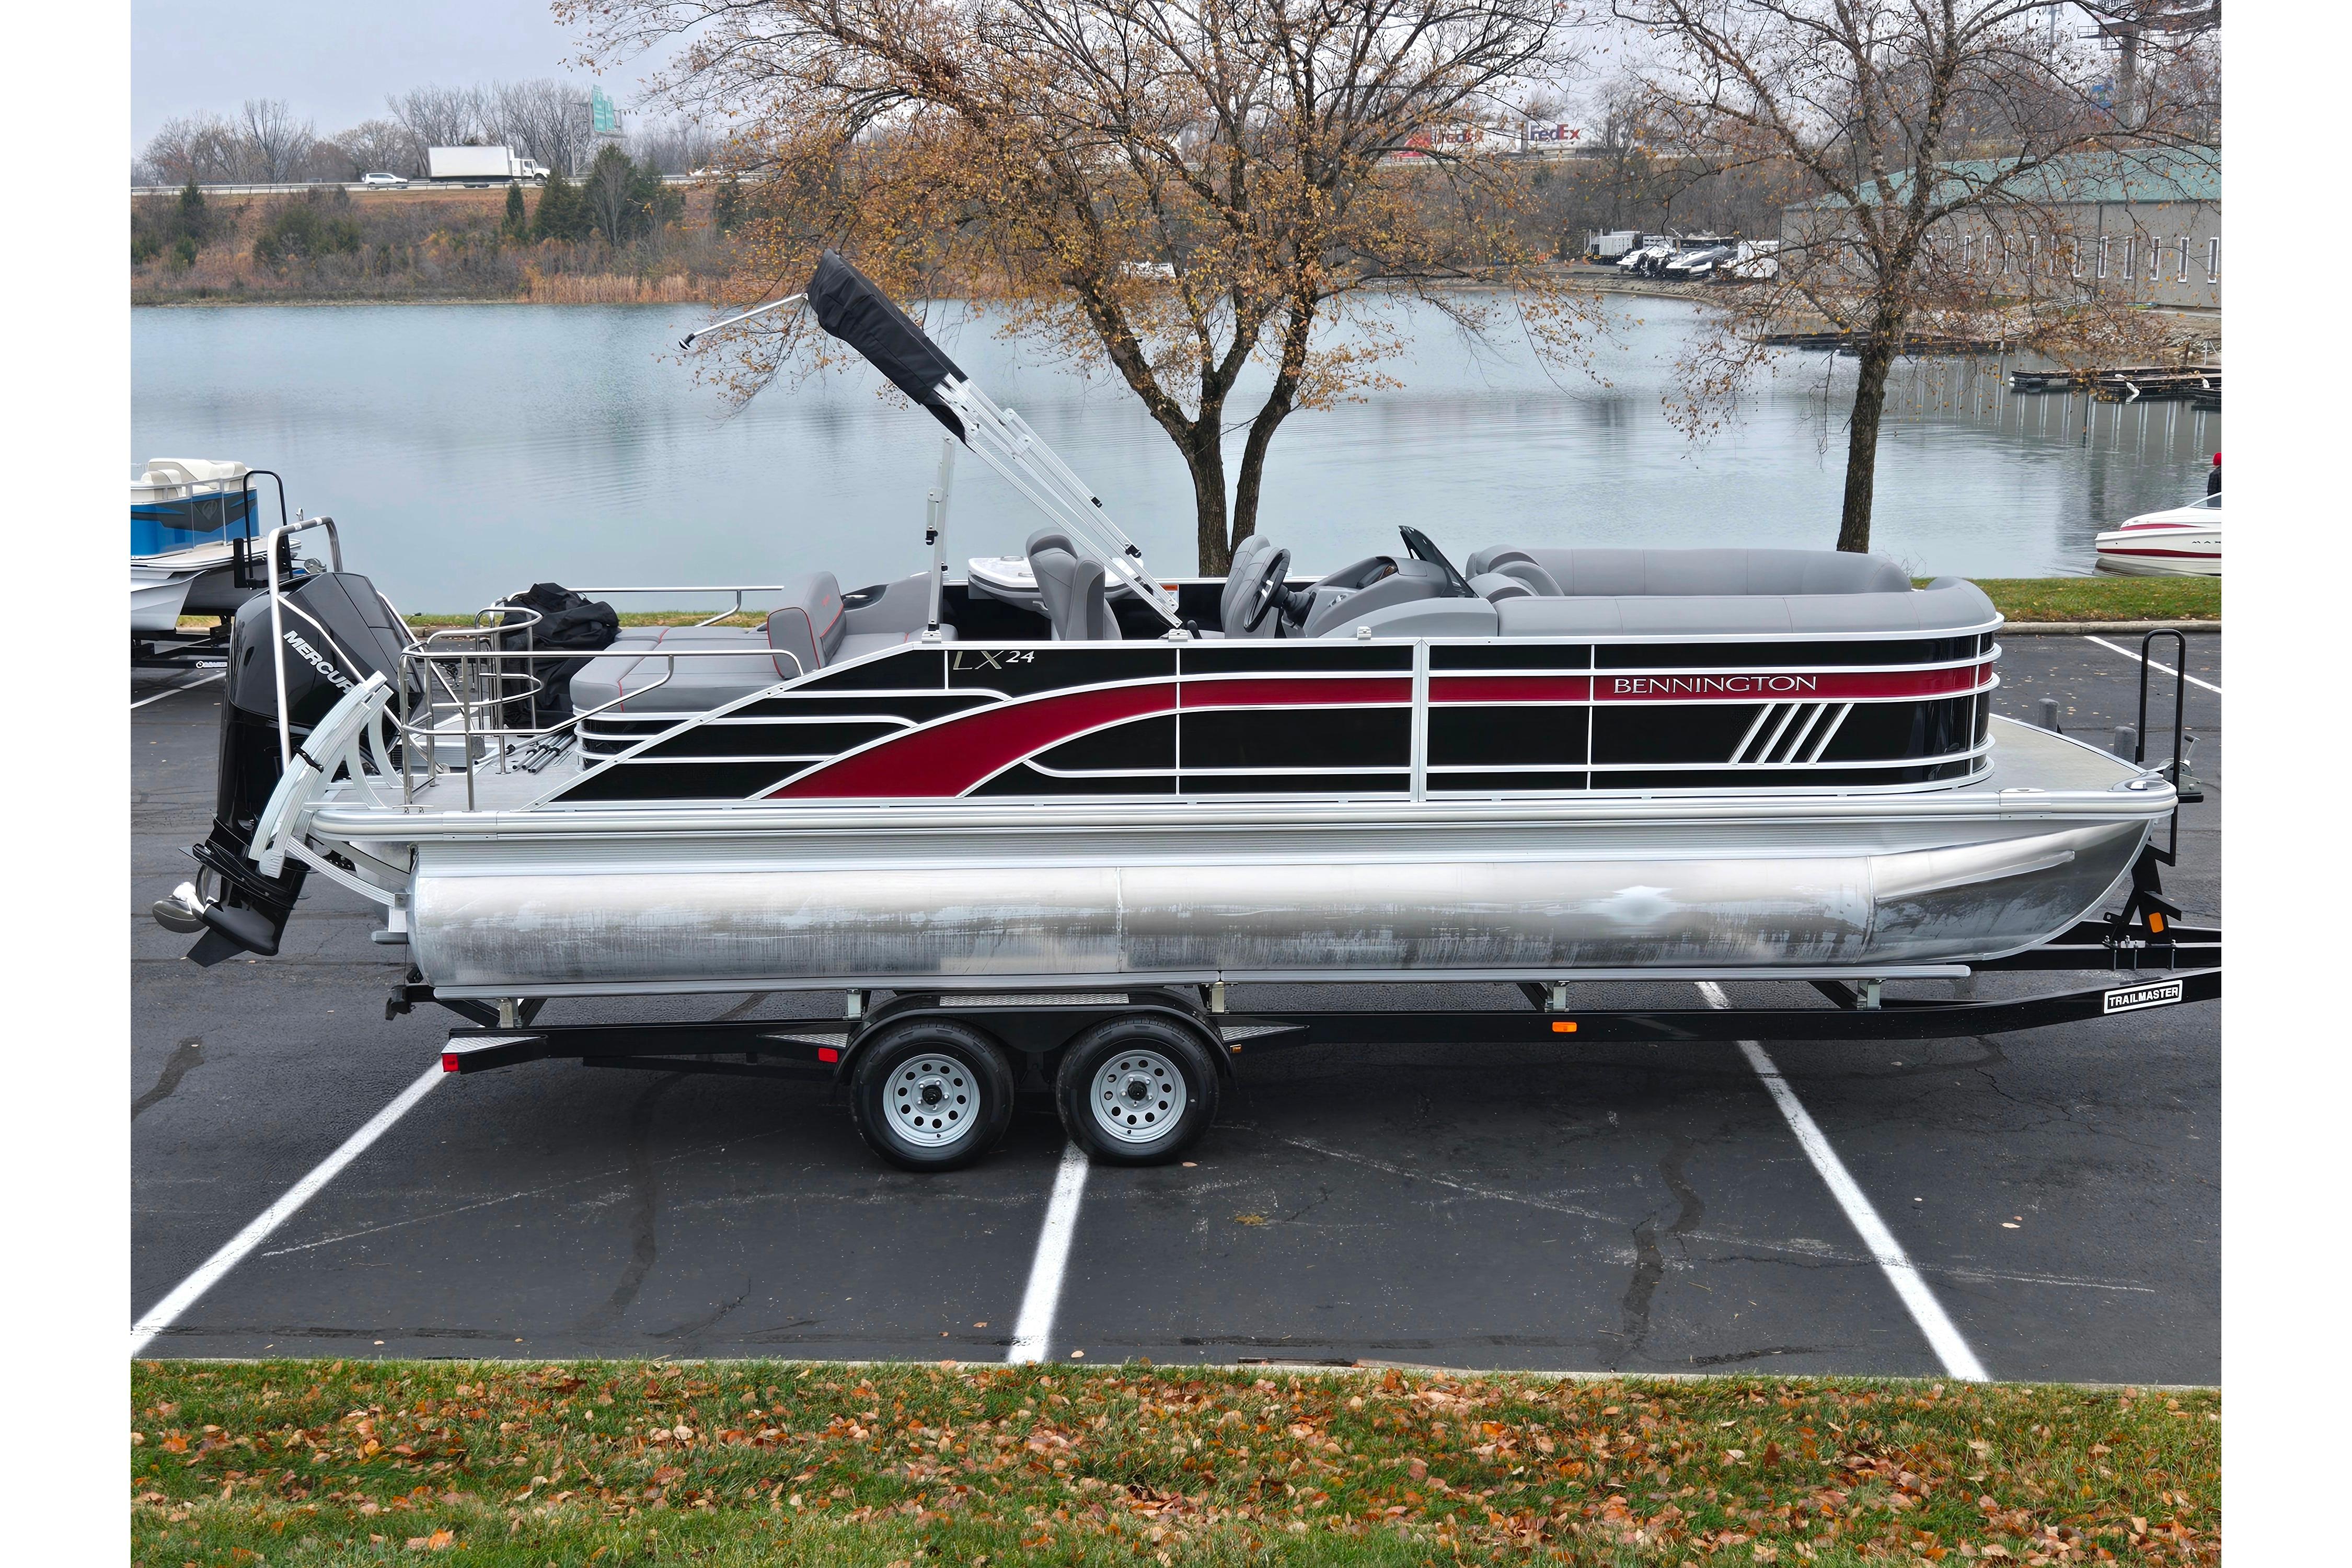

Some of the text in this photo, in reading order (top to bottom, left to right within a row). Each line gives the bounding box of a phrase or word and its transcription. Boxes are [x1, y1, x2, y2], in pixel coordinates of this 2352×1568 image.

[1530, 124, 1581, 141] FedEx
[283, 630, 355, 694] MERCUR
[1614, 676, 1816, 694] BENNINGTON
[2109, 987, 2178, 1007] TRAILMASTER
